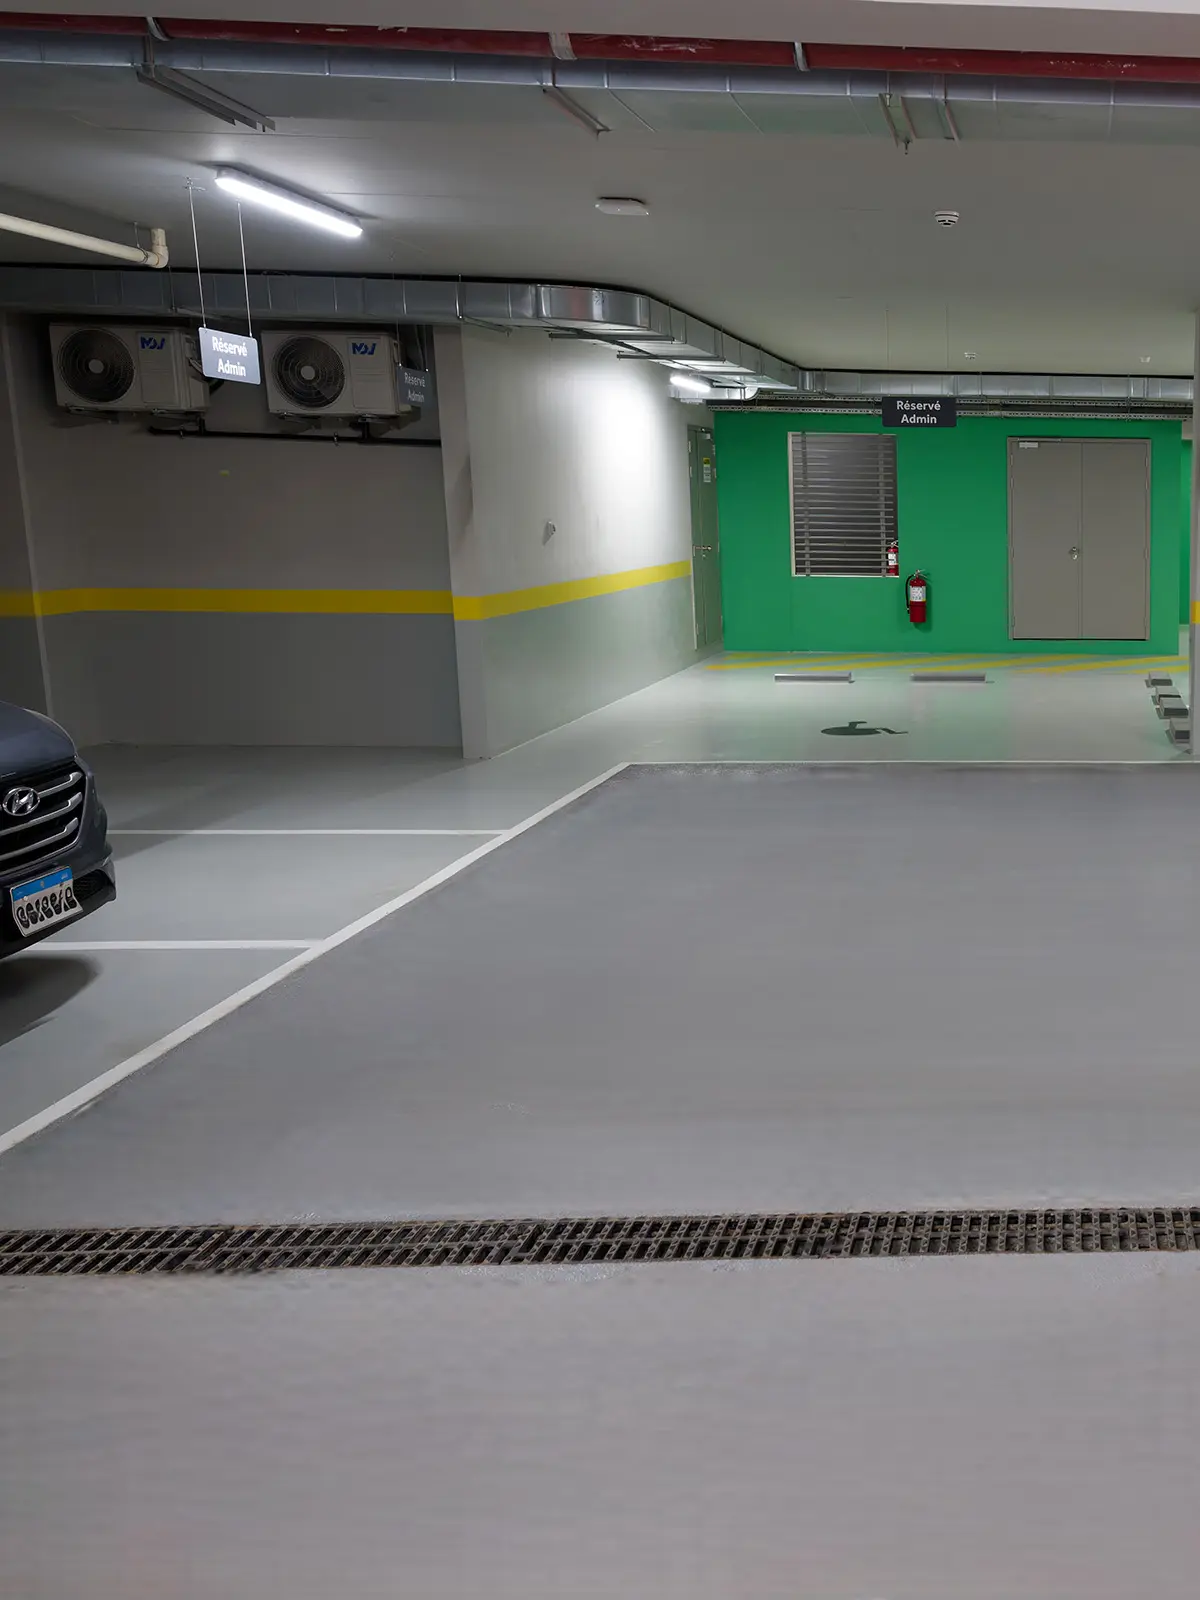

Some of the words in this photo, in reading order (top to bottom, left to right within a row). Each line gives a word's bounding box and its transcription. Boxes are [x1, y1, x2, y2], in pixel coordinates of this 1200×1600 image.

[211, 336, 248, 357] Réservé
[217, 358, 247, 377] Admin
[404, 372, 426, 387] Réservé
[407, 389, 425, 402] Admin
[896, 400, 941, 411] Réservé
[900, 413, 937, 424] Admin
